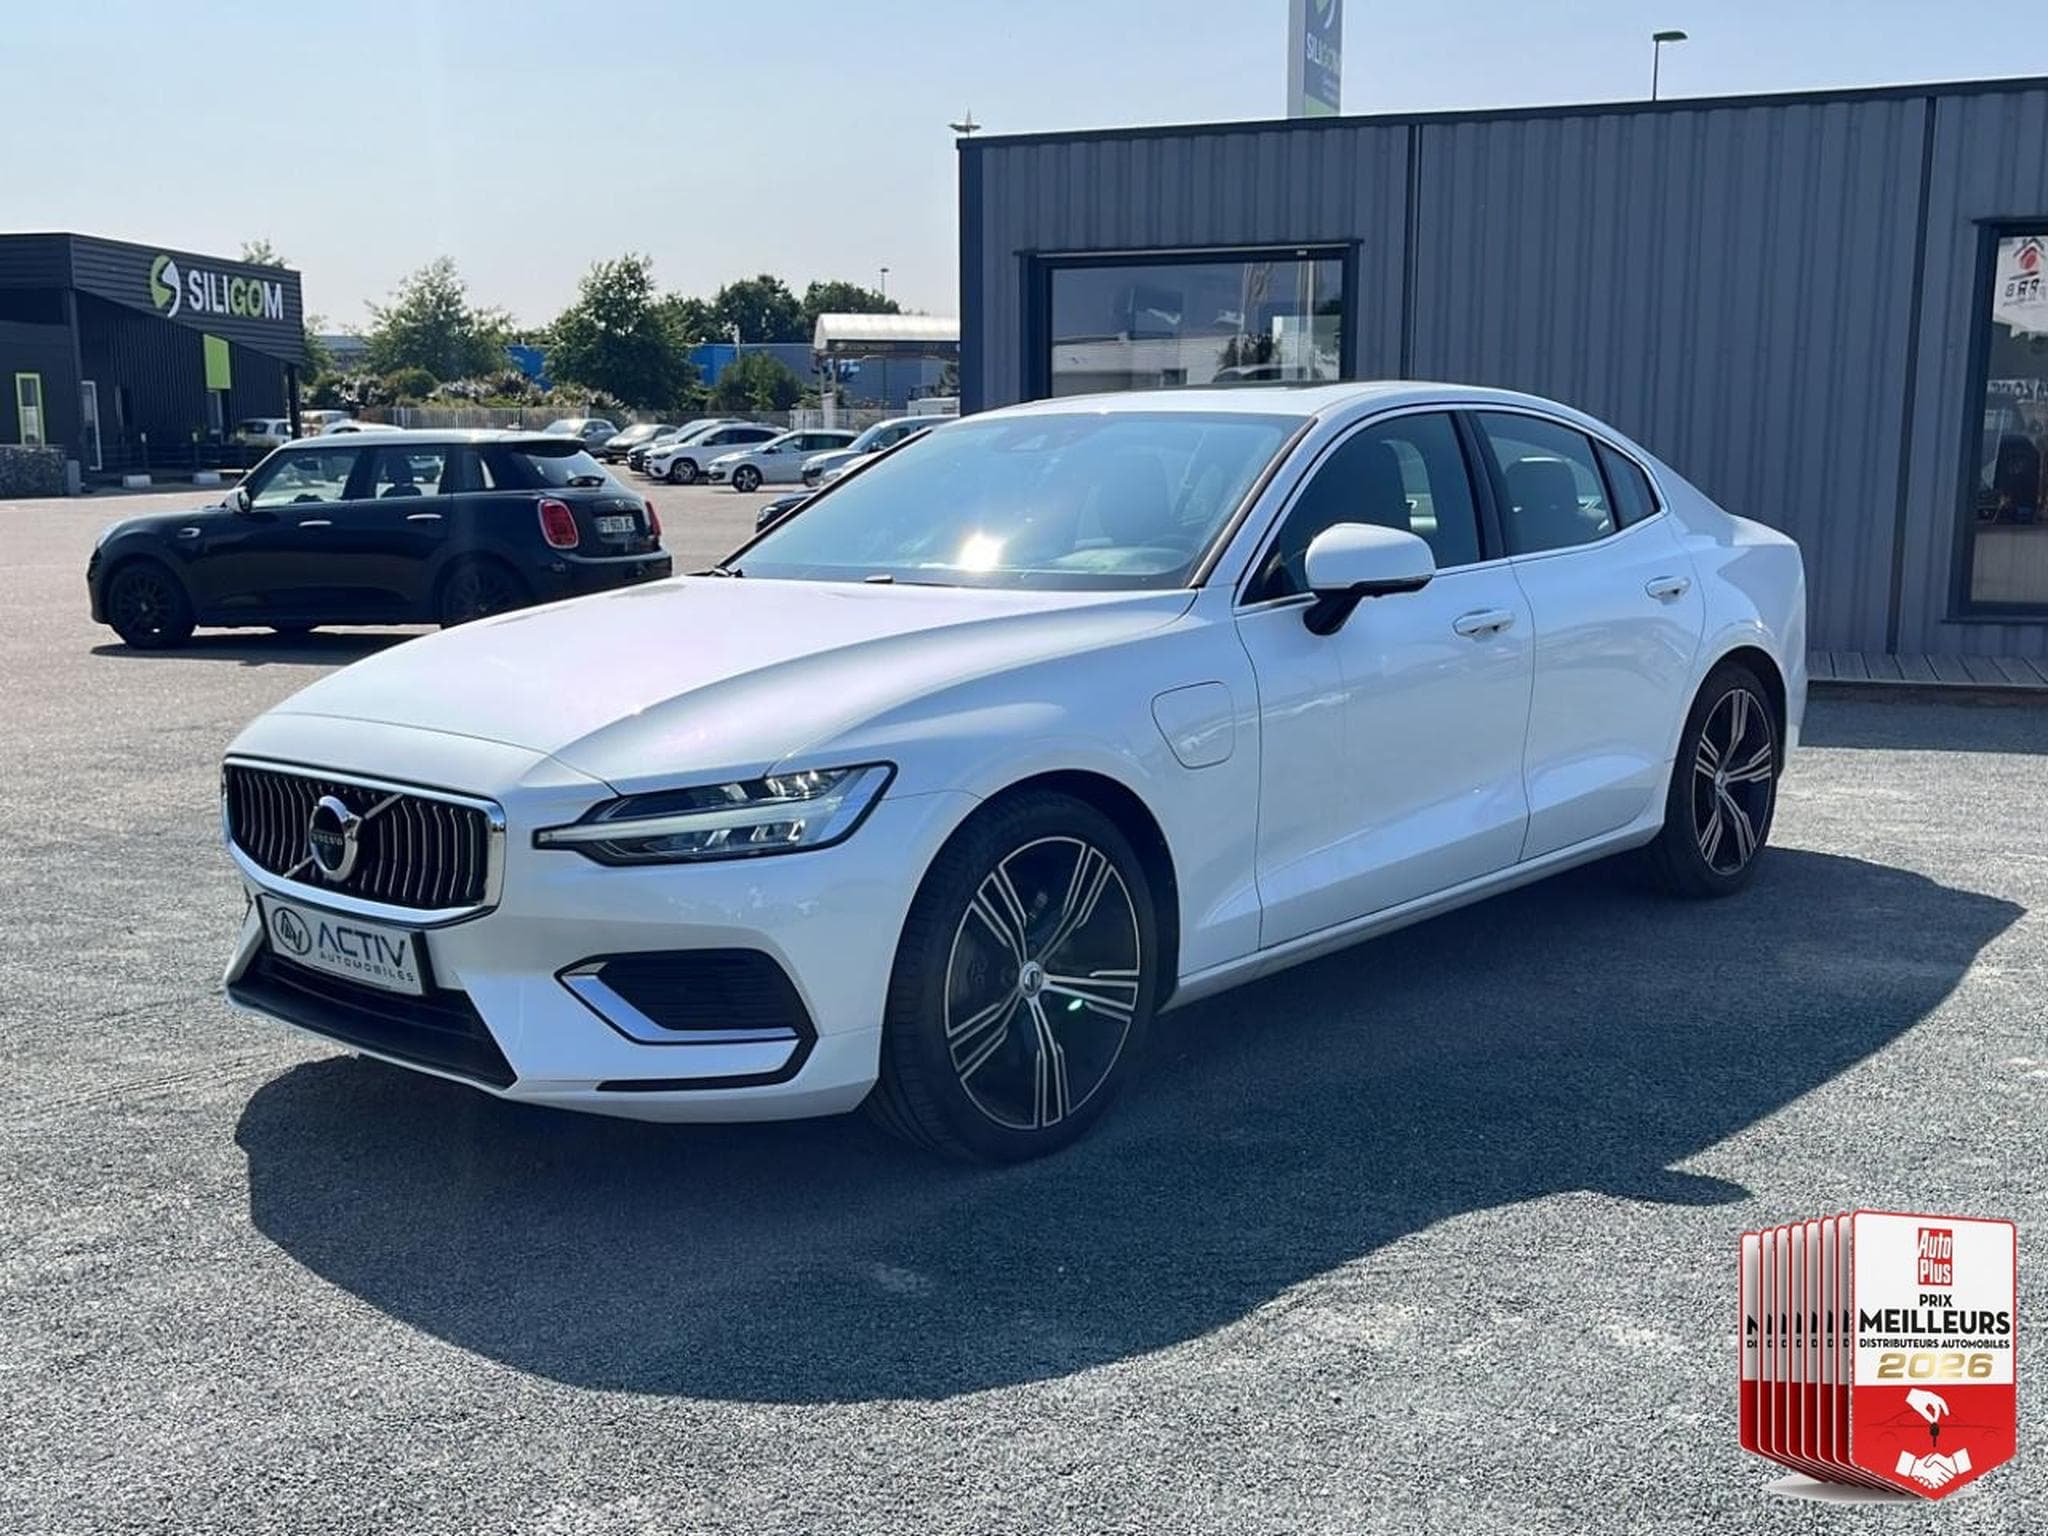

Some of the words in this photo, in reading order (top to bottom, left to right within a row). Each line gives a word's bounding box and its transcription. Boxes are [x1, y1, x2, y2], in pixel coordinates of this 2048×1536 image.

[188, 269, 284, 320] SILIGOM
[318, 921, 406, 968] ACTIV
[319, 951, 415, 983] AUTOMOBILES
